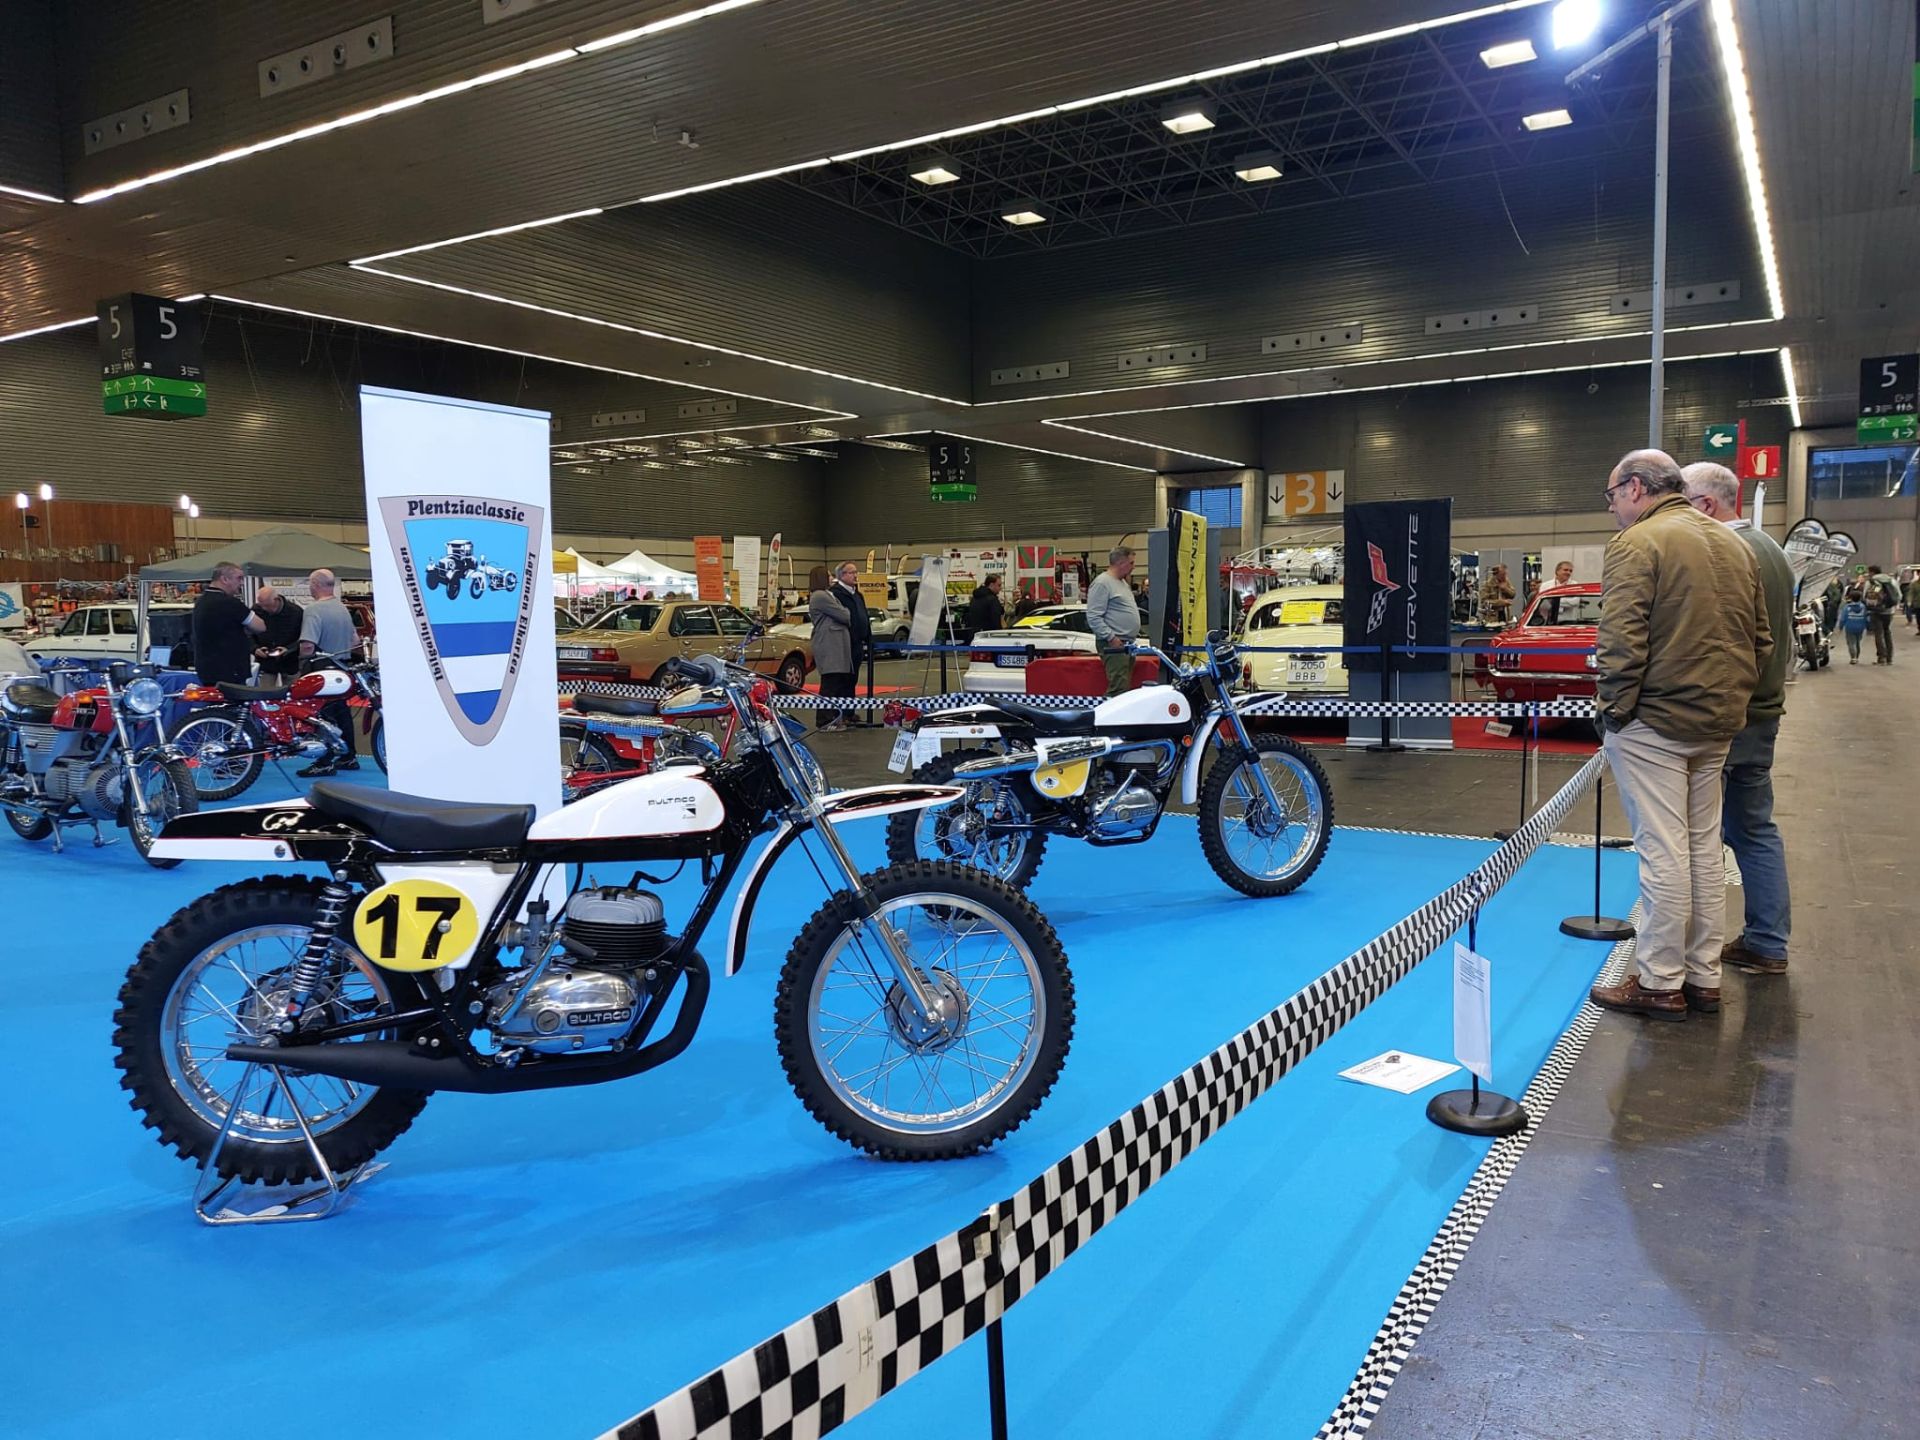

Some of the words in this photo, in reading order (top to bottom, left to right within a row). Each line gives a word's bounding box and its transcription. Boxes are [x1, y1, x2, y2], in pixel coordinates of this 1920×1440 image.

[109, 305, 121, 339] 5
[159, 306, 178, 340] 5
[180, 365, 187, 376] 3
[1881, 361, 1898, 388] 5
[940, 447, 948, 465] 5
[964, 447, 970, 464] 5
[408, 500, 525, 521] Plentziaclassic
[1295, 473, 1316, 514] 3
[400, 547, 425, 618] Klasikoen
[522, 551, 536, 611] Lagunen
[1406, 512, 1419, 659] CORVETTE
[420, 622, 444, 681] Ibilgailu
[509, 614, 528, 675] Elkartea
[1290, 662, 1297, 670] H
[1301, 661, 1325, 670] 2050
[648, 796, 696, 806] BULTACO
[365, 893, 461, 960] 17
[569, 1010, 630, 1025] BULTACO
